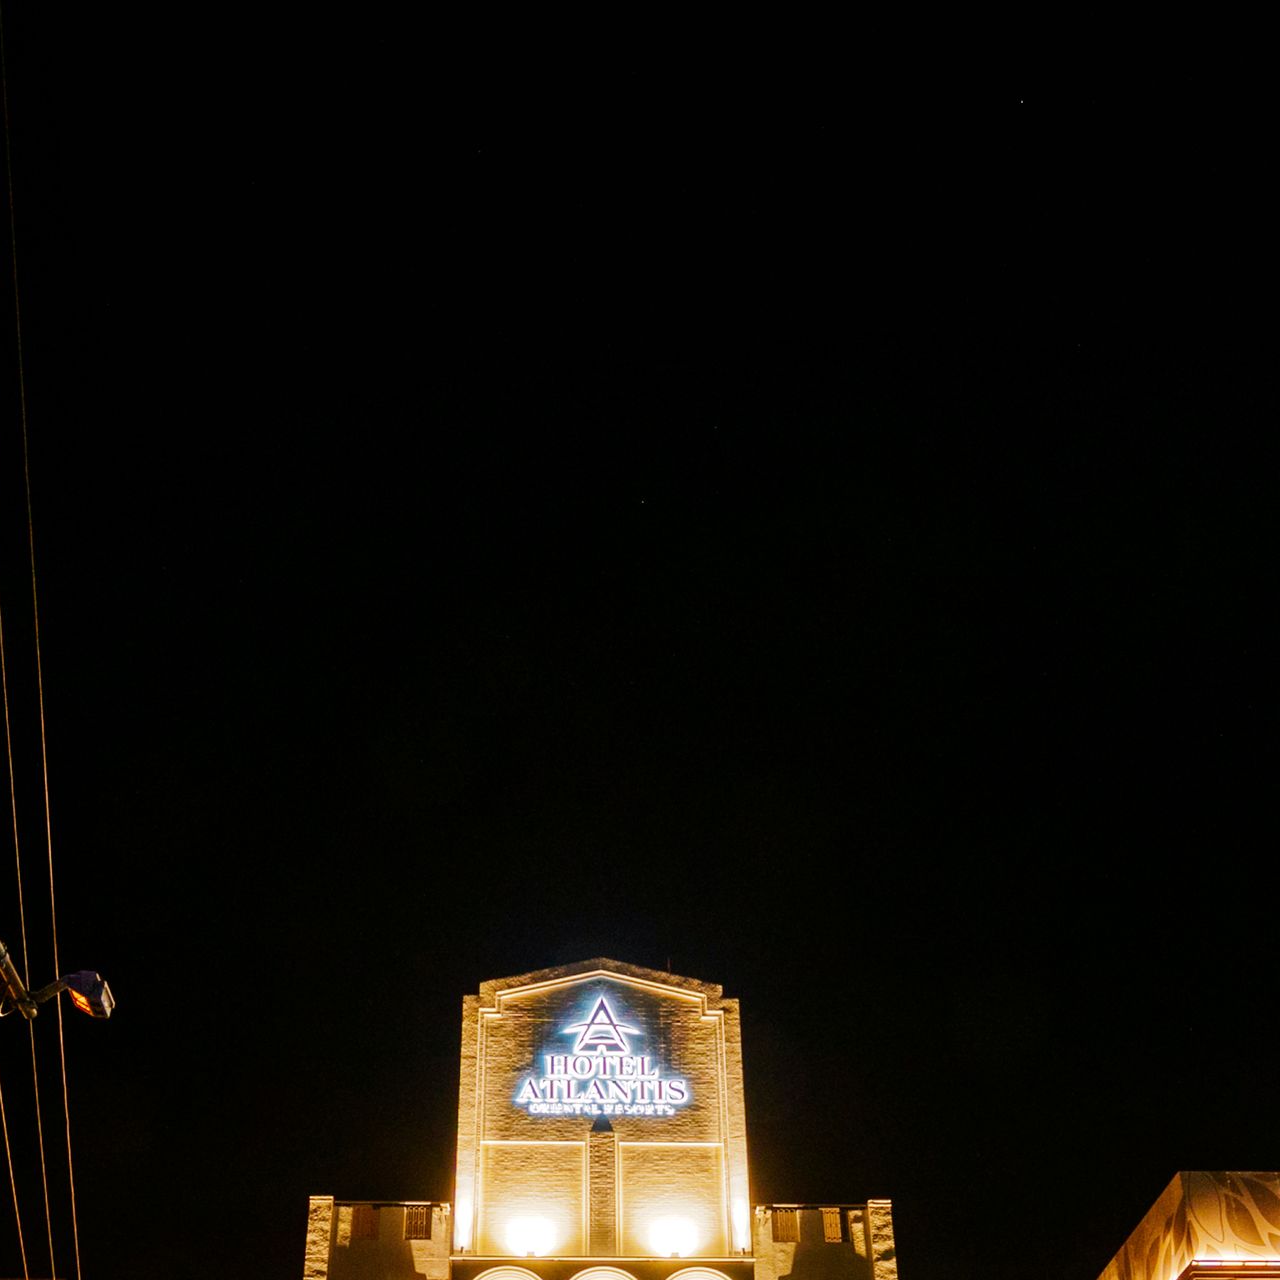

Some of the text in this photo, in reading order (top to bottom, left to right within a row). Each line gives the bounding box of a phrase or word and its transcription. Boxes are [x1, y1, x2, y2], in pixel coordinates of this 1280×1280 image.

[546, 1054, 659, 1079] HOTEL
[515, 1078, 689, 1104] ATLANTIS
[603, 1103, 675, 1115] RESORTS
